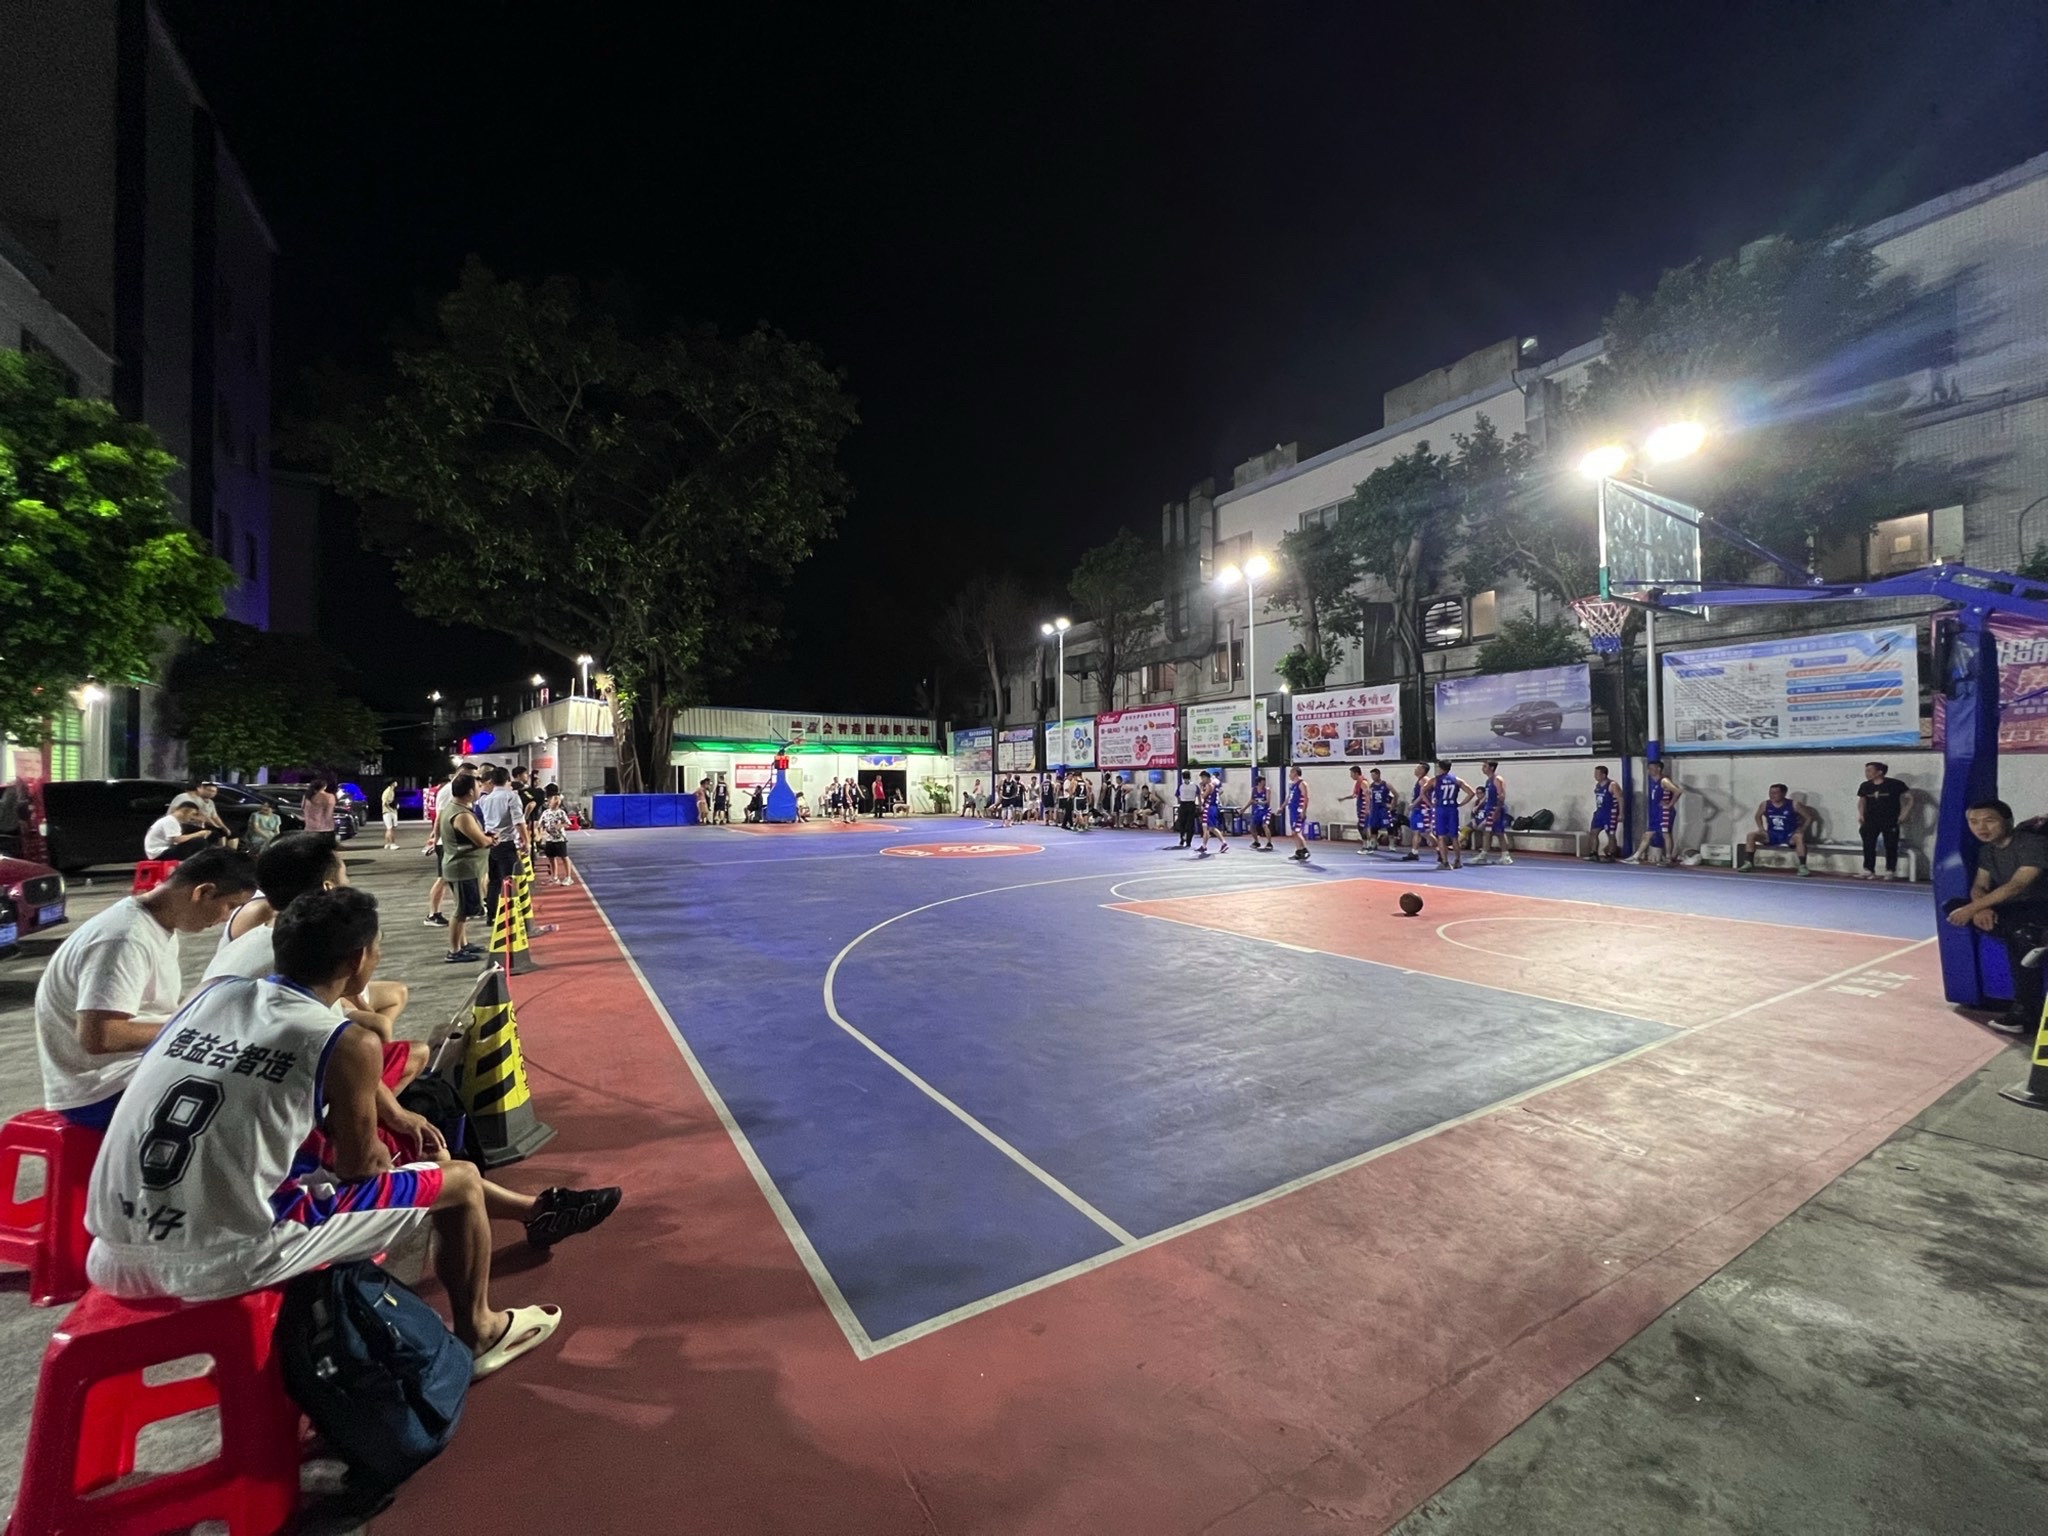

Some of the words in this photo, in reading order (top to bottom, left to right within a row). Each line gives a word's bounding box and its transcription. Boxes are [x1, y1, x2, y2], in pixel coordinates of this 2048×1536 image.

[1440, 784, 1456, 799] 77
[163, 1027, 298, 1084] 德益会智造
[138, 1074, 225, 1191] 8
